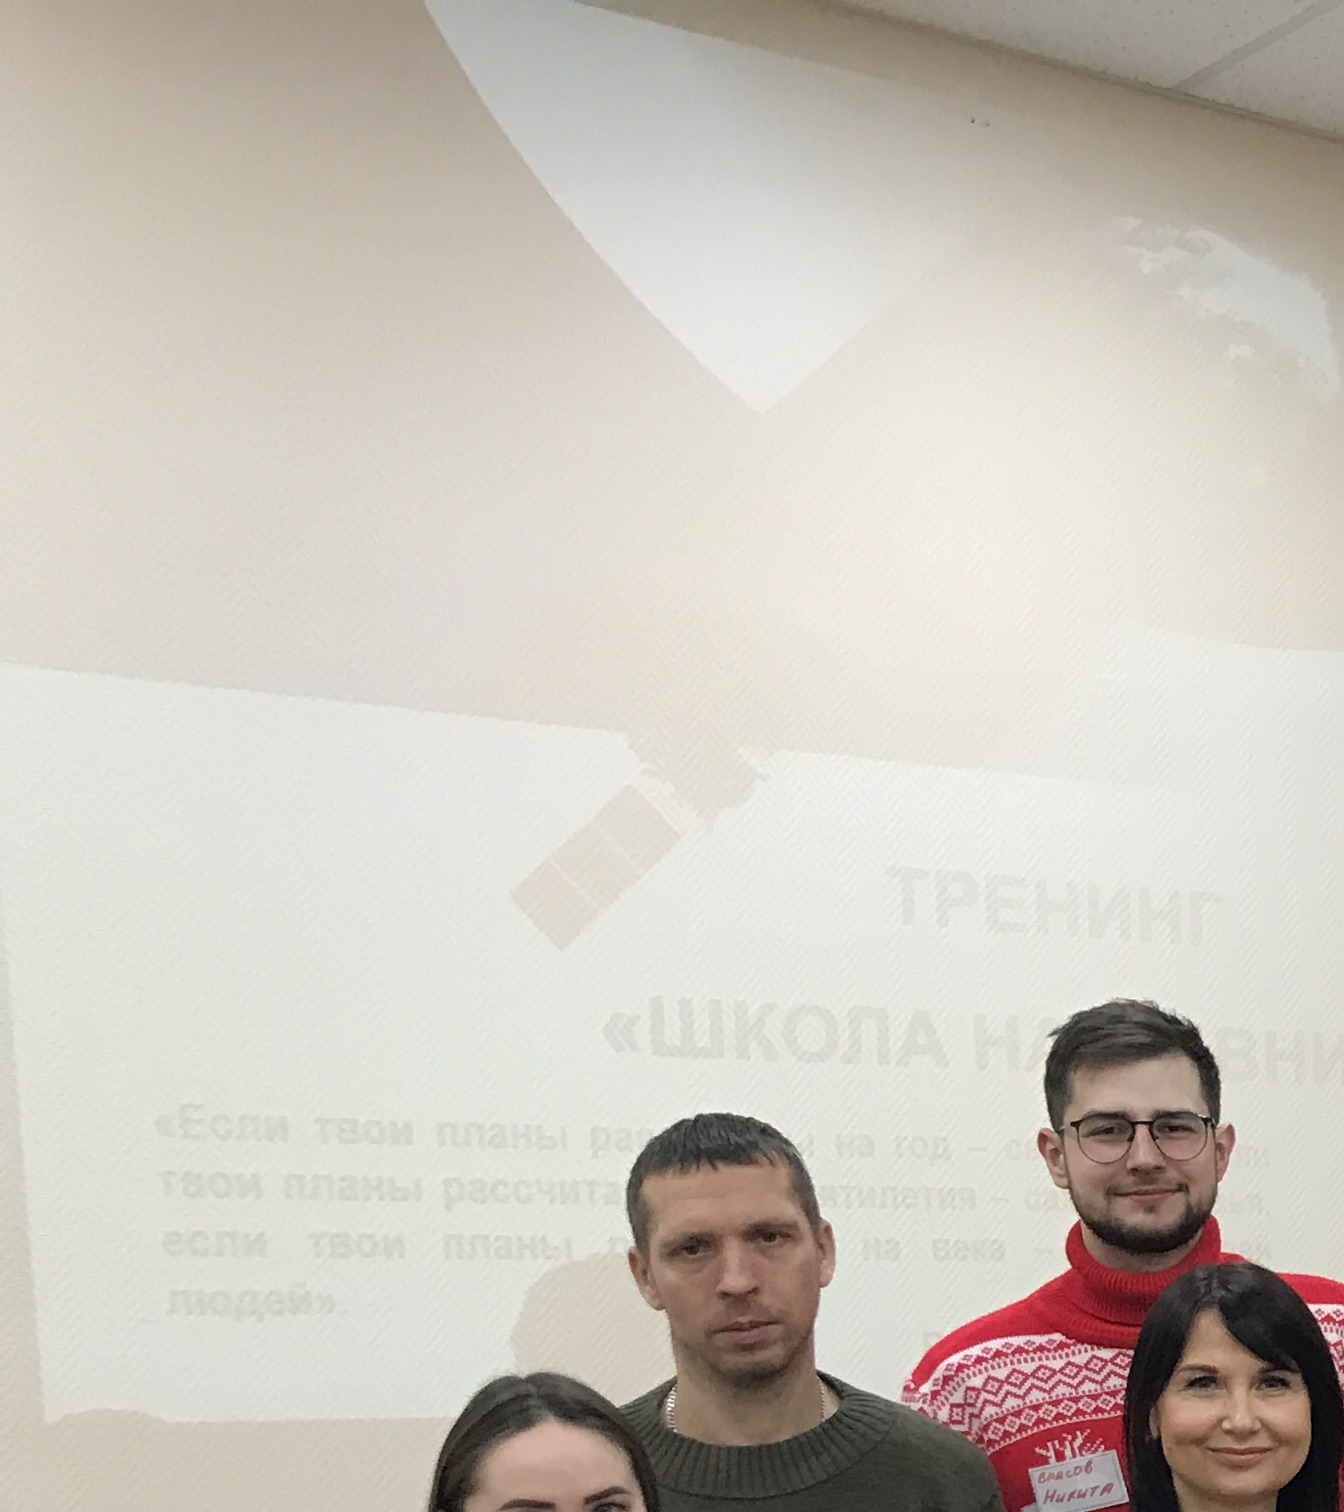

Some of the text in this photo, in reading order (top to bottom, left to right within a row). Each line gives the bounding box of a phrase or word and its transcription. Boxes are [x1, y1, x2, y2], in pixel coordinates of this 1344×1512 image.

[888, 864, 1224, 947] ТРЕНИНГ
[603, 997, 950, 1069] «ШКОЛА
[155, 1102, 291, 1143] «Если
[314, 1117, 415, 1147] твои
[435, 1121, 568, 1152] планы
[894, 1136, 952, 1164] год
[158, 1170, 264, 1200] твои
[283, 1173, 423, 1204] планы
[441, 1177, 628, 1212] рассчита
[161, 1229, 269, 1259] если
[307, 1231, 407, 1260] твои
[442, 1233, 575, 1262] планы
[862, 1236, 902, 1262] на
[933, 1236, 1007, 1263] века
